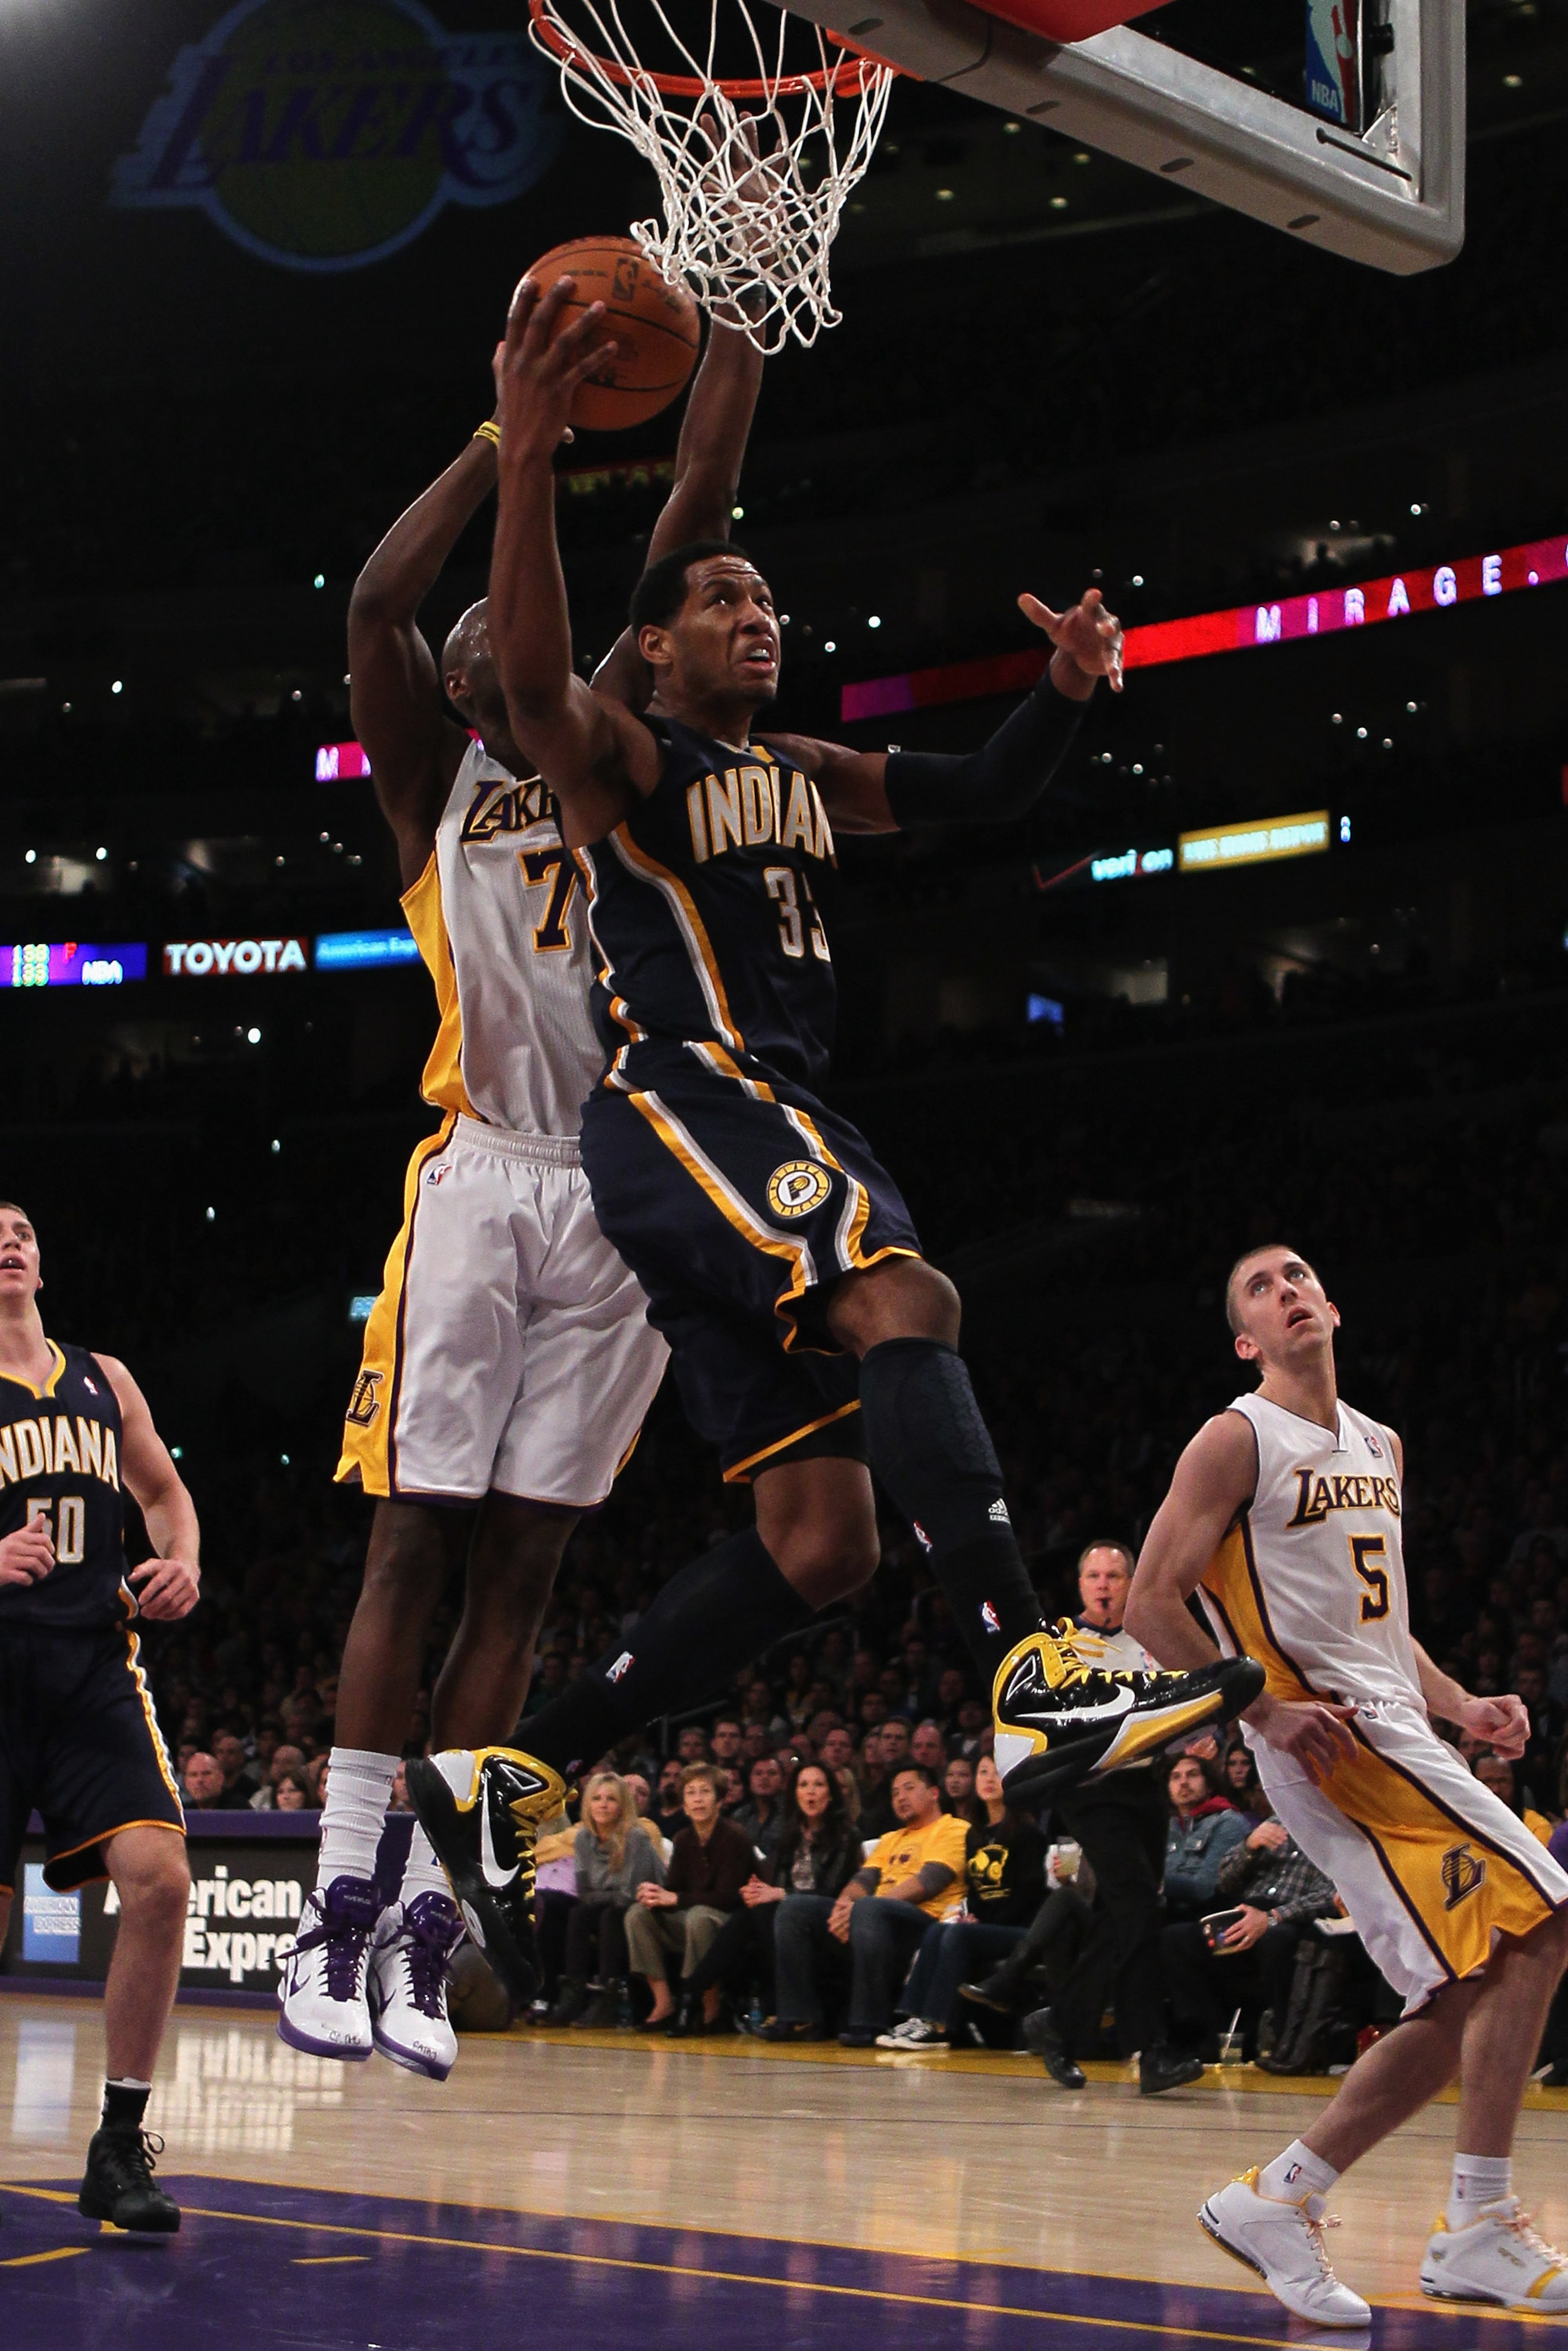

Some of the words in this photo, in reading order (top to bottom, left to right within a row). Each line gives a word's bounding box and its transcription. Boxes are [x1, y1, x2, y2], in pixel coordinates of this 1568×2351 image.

[1312, 80, 1338, 112] NBA
[1255, 542, 1568, 644] MIRAGE.
[518, 844, 576, 954] 7
[165, 940, 307, 975] TOYOTA
[1286, 1466, 1401, 1530] LAKERS
[1349, 1533, 1390, 1624] 5
